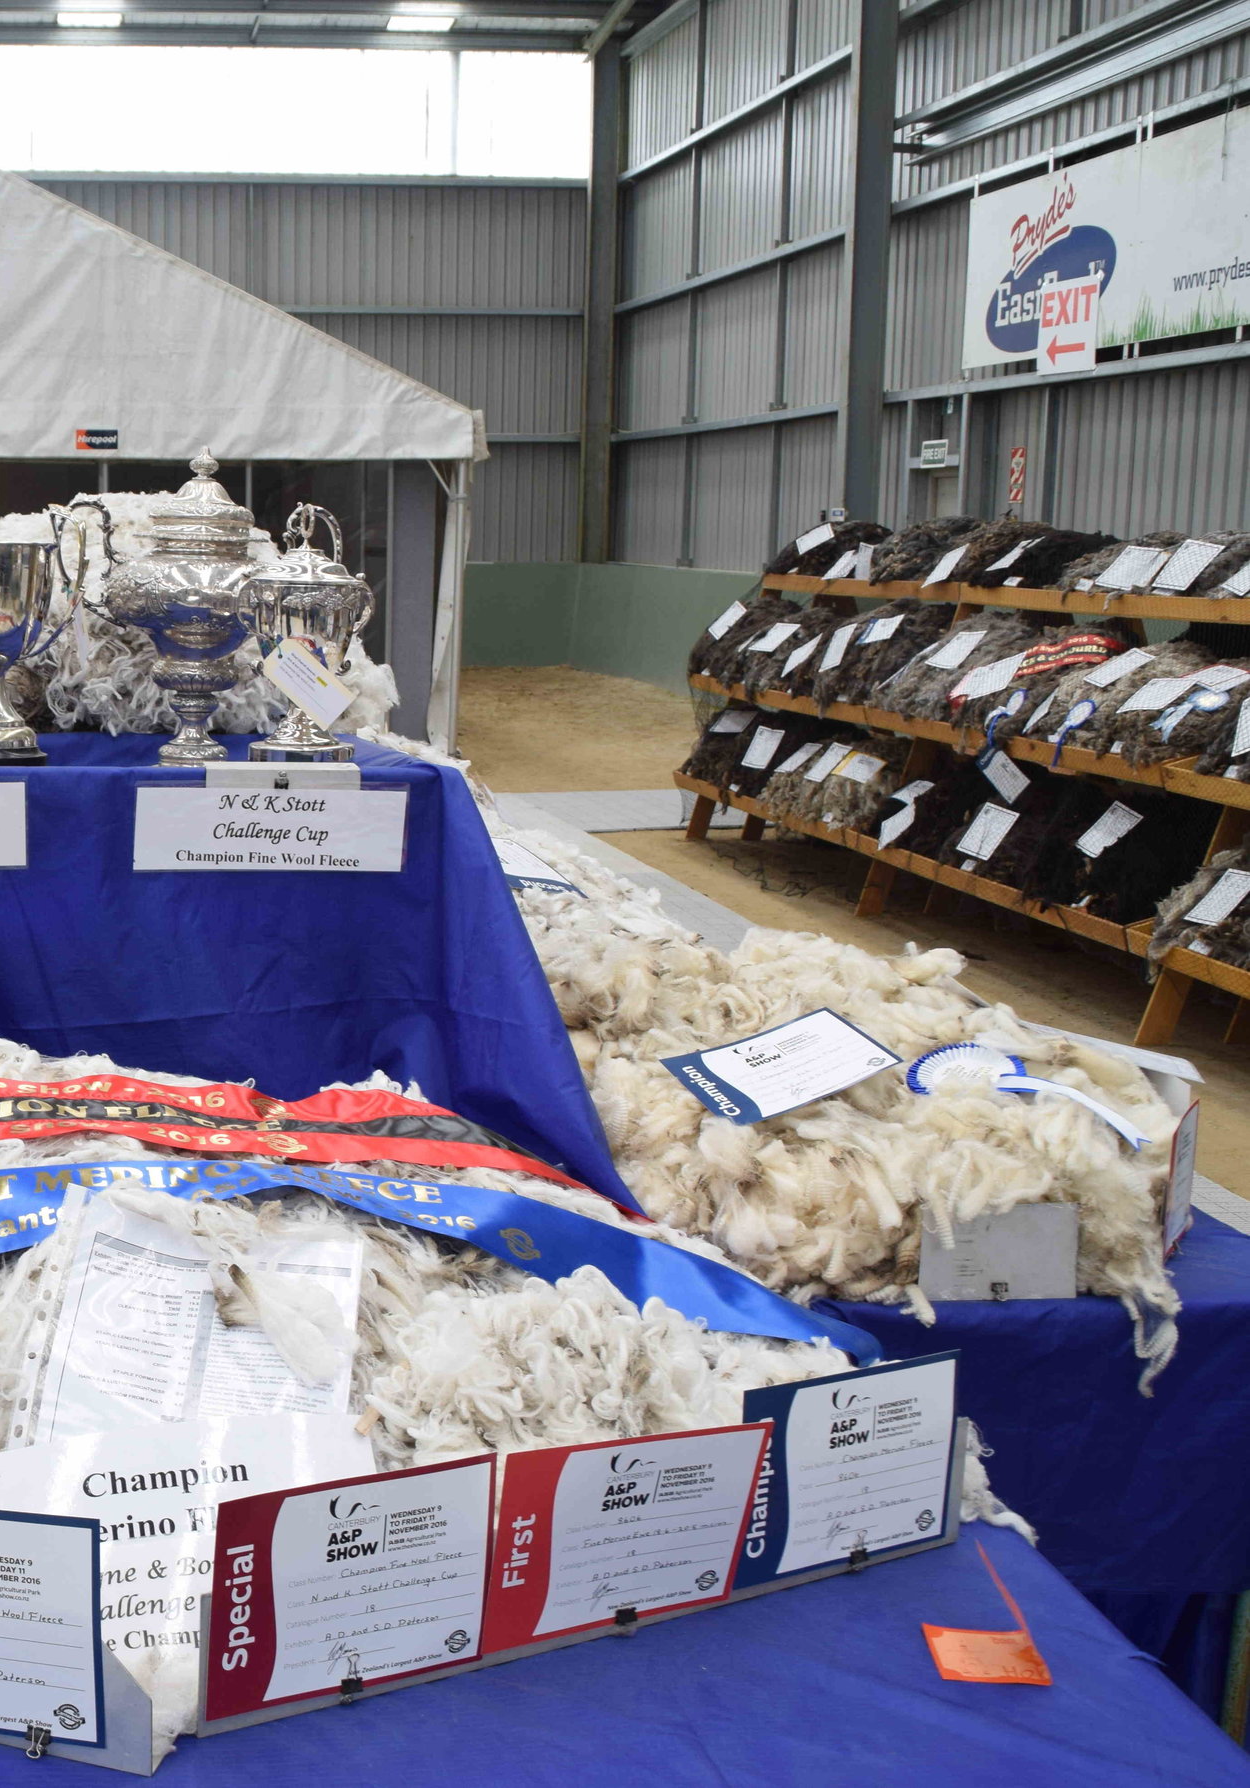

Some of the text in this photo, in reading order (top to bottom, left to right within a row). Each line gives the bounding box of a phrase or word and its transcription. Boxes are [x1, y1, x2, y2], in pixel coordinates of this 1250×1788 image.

[1041, 284, 1098, 328] EXIT
[77, 435, 118, 445] Hirepool
[218, 793, 326, 813] N & K Stott
[213, 821, 329, 846] Challenge Cup
[175, 849, 360, 868] Champion Fine Wool Fleece
[744, 1052, 766, 1064] A&P
[749, 1053, 782, 1068] SHOW
[682, 1065, 742, 1117] Champion
[148, 1126, 232, 1146] 2016
[33, 1161, 243, 1194] MERINO
[398, 1215, 478, 1231] 2016
[829, 1418, 858, 1435] A&P
[828, 1430, 871, 1450] SHOW
[83, 1459, 251, 1499] Champion
[604, 1481, 637, 1498] A&P
[601, 1492, 650, 1512] SHOW
[389, 1520, 401, 1528] TO
[401, 1516, 427, 1526] FRIDAY
[390, 1506, 436, 1519] WEDNESDAY
[99, 1514, 176, 1544] erino
[327, 1515, 381, 1531] CANTERBURY
[388, 1520, 448, 1536] NOVEMBER 2016
[327, 1528, 363, 1546] A&P
[326, 1541, 379, 1563] SHOW
[502, 1512, 536, 1589] First
[18, 1567, 26, 1575] 11
[27, 1559, 33, 1567] 9
[147, 1559, 168, 1580] &
[21, 1577, 41, 1586] 2016
[100, 1593, 196, 1621] allenge
[221, 1543, 256, 1671] Special
[2, 1609, 25, 1620] Wool
[29, 1612, 64, 1625] Fleece
